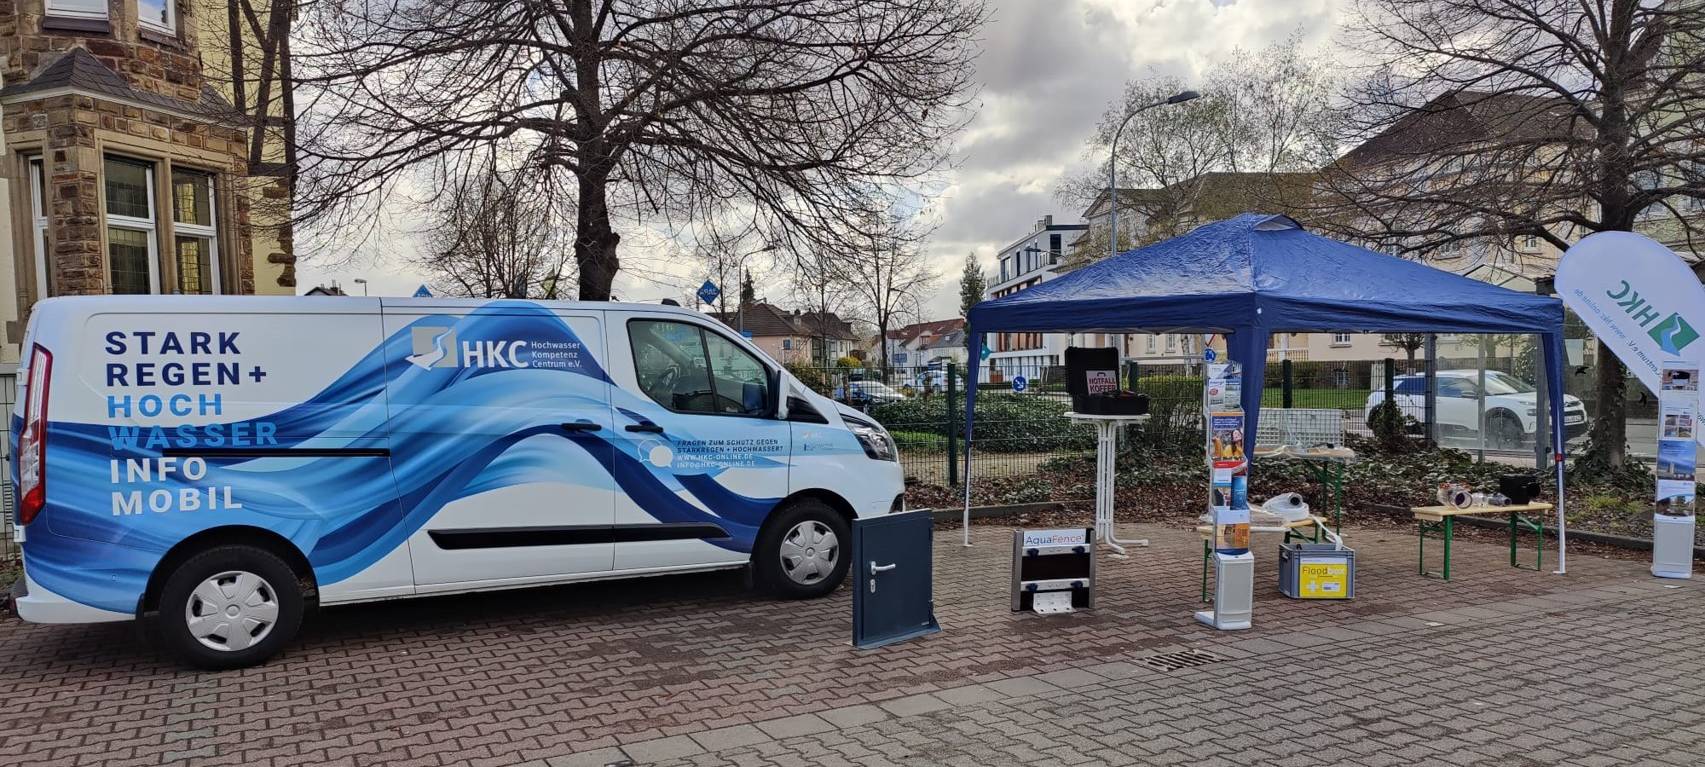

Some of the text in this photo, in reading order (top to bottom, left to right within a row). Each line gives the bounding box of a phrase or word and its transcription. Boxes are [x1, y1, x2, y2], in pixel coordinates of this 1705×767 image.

[105, 331, 241, 355] STARK
[531, 341, 581, 350] Hochwasser
[463, 340, 531, 368] HKC
[531, 350, 578, 360] Kompetenz
[532, 359, 582, 369] Centrum e.V.
[1088, 377, 1116, 385] NOTFALL
[1089, 384, 1117, 393] KOFFER
[107, 393, 223, 418] HOCH
[107, 421, 279, 450] WASSER
[677, 439, 706, 447] FRAGEN
[110, 456, 208, 484] INFO
[111, 485, 243, 516] MOBIL
